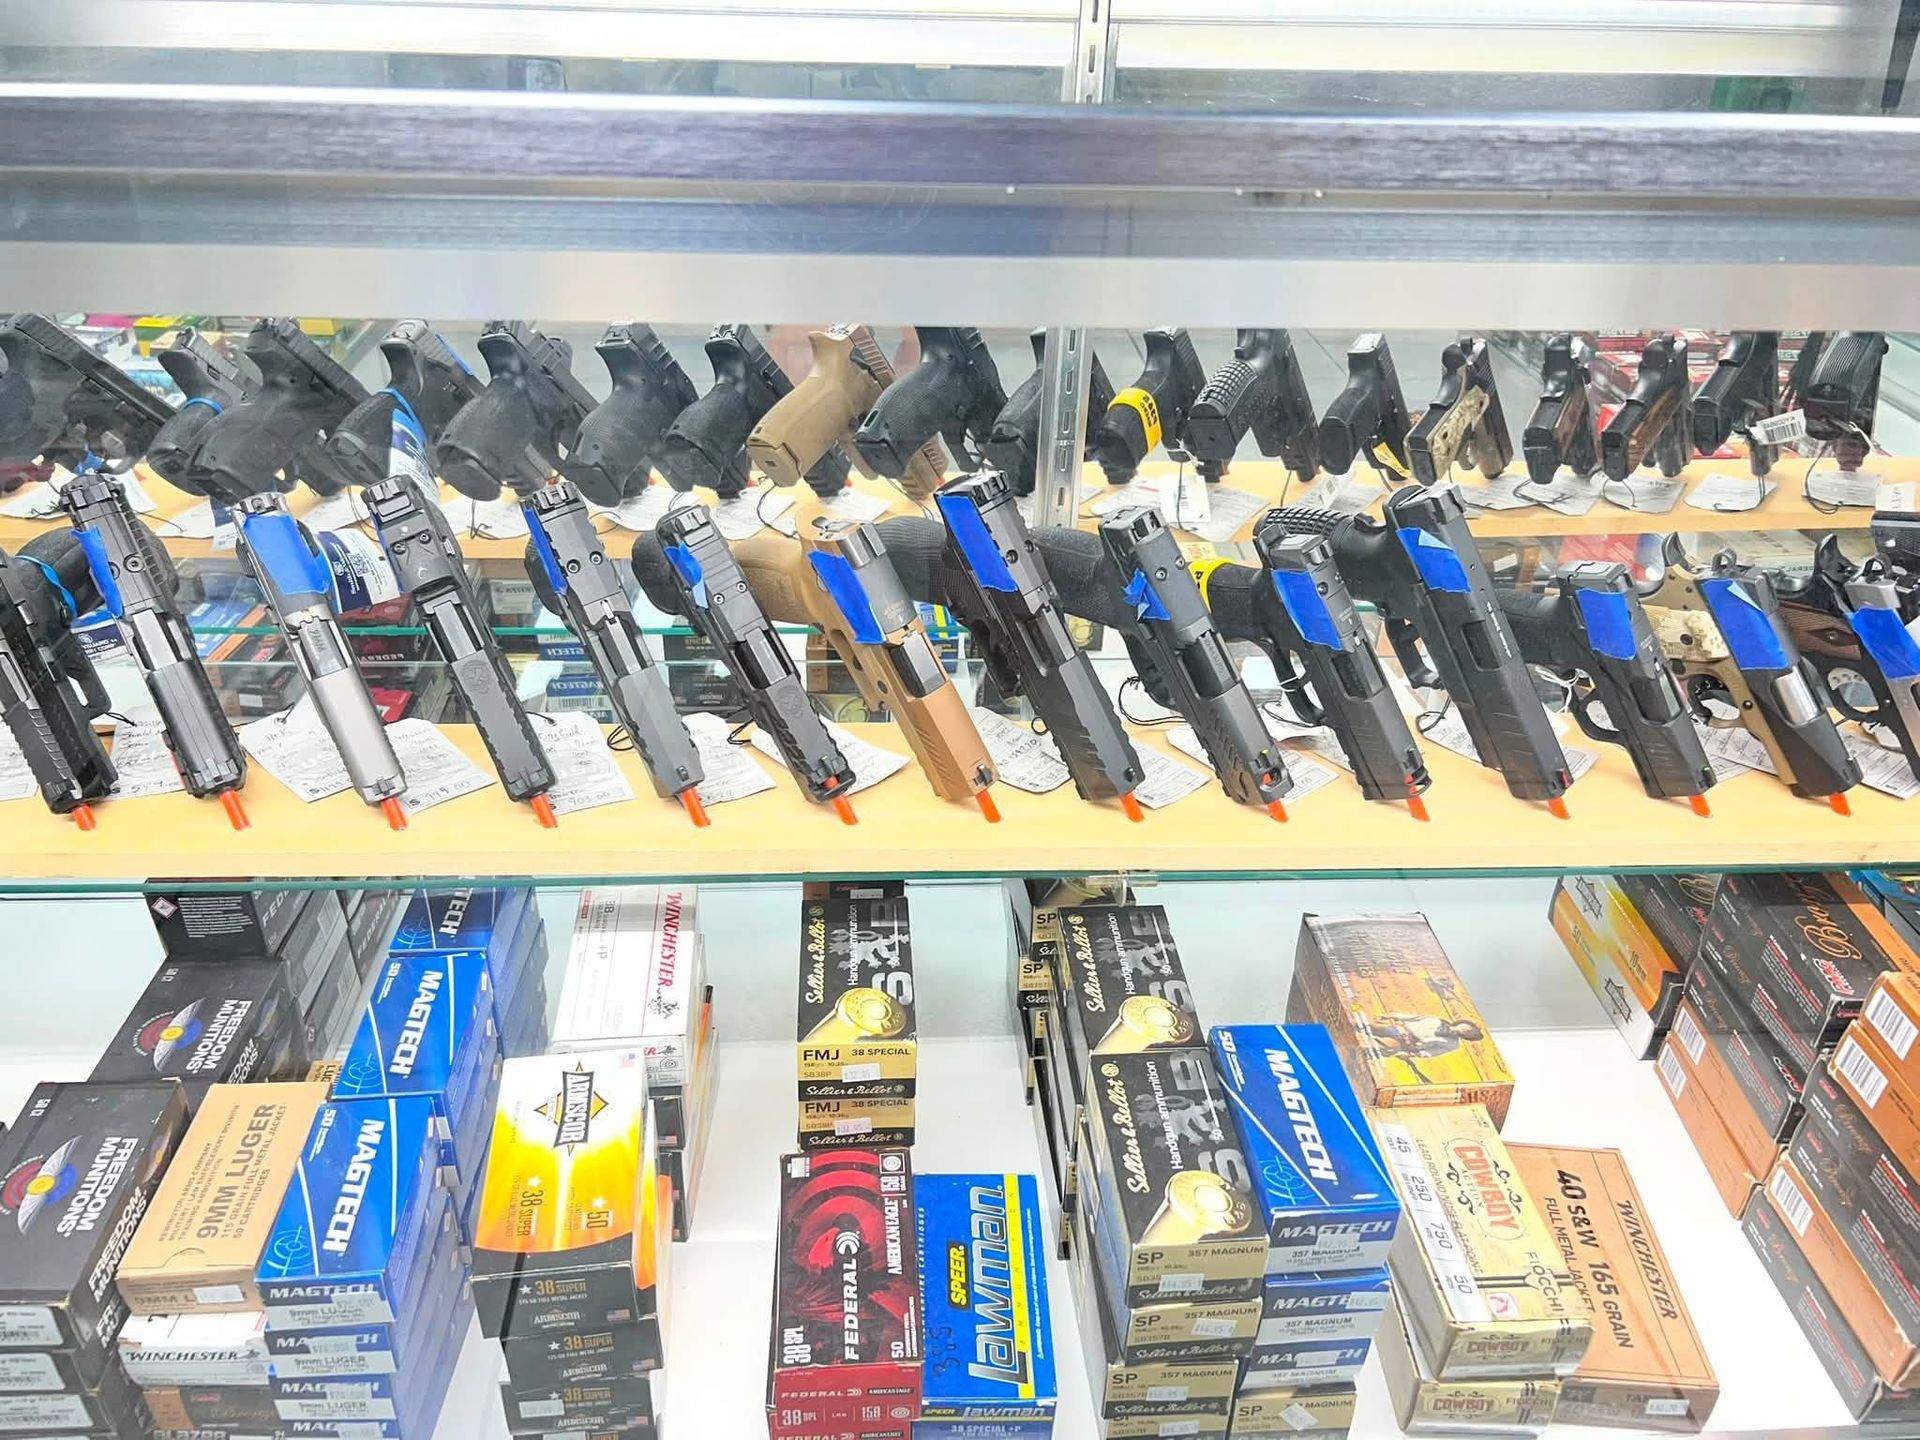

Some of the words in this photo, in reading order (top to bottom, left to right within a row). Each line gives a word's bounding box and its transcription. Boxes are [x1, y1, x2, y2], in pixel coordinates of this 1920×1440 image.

[438, 886, 475, 936] TECH
[1037, 913, 1057, 924] SP
[657, 892, 682, 988] WINCHESTER
[1072, 925, 1095, 962] Bellot
[1108, 912, 1126, 957] ammunition
[1023, 964, 1044, 974] SP
[1120, 959, 1136, 995] Handgun
[186, 999, 239, 1074] MUNITIONS
[202, 1000, 253, 1070] FREEDOM
[389, 970, 443, 1078] MAGTECH
[226, 1038, 255, 1084] EDOM
[803, 1049, 840, 1061] FMJ
[851, 1048, 865, 1056] 38
[867, 1048, 910, 1056] SPECIAL
[805, 1085, 845, 1096] Sellier
[854, 1085, 892, 1095] Bellot
[1107, 1077, 1134, 1127] Bellot
[1146, 1060, 1170, 1122] ammunition
[560, 1073, 593, 1145] ARMSCOR
[805, 1101, 840, 1113] FMJ
[867, 1099, 909, 1107] SPECIAL
[1264, 1048, 1338, 1185] MAGTECH
[809, 1136, 846, 1146] Sellier
[856, 1135, 892, 1144] Bellot
[1163, 1122, 1184, 1170] Handgun
[196, 1185, 240, 1239] 9MM
[225, 1103, 278, 1178] LUGER
[243, 1166, 260, 1190] FULL
[254, 1137, 273, 1168] METAL
[1122, 1137, 1150, 1193] Sellier
[57, 1136, 121, 1238] MUNITIONS
[76, 1137, 139, 1232] FREEDOM
[239, 1168, 271, 1226] CARTRIDGES
[322, 1119, 386, 1253] MAGTECH
[1411, 1175, 1433, 1202] 250
[1453, 1145, 1520, 1231] COWBOY
[1558, 1169, 1587, 1200] 40
[521, 1189, 544, 1208] 38
[883, 1198, 900, 1226] EAGLE
[515, 1209, 535, 1236] SUPER
[586, 1210, 610, 1230] 50
[1278, 1220, 1393, 1239] MAGTECH
[1567, 1204, 1600, 1249] S&W
[88, 1186, 142, 1291] FREEDOM
[94, 1190, 147, 1303] MUNITIONS
[1430, 1221, 1453, 1250] 750
[885, 1226, 903, 1275] AMERICAN
[1136, 1251, 1164, 1265] SP
[1187, 1249, 1210, 1258] 357
[1211, 1246, 1265, 1256] MAGNUM
[1291, 1250, 1308, 1258] 357
[1544, 1196, 1564, 1225] FULL
[1555, 1226, 1578, 1264] METAL
[1567, 1266, 1597, 1313] JACKET
[1616, 1199, 1679, 1321] WINCHESTER
[535, 1279, 555, 1296] 38
[556, 1282, 587, 1295] SUPER
[949, 1244, 968, 1307] SPEER
[968, 1184, 1028, 1385] Lawman
[1453, 1274, 1473, 1295] 50
[1525, 1251, 1565, 1313] FIOCCHI
[1588, 1261, 1620, 1297] 165
[269, 1282, 375, 1299] MAGTECH
[1272, 1294, 1352, 1311] MAGTE
[534, 1311, 581, 1325] ARMSCOR
[842, 1258, 860, 1361] FEDERAL
[1134, 1314, 1161, 1328] SP
[1184, 1312, 1206, 1320] 357
[1207, 1308, 1258, 1318] MAGNUM
[1284, 1320, 1302, 1328] 357
[1304, 1317, 1353, 1327] MAGNUM
[1603, 1300, 1635, 1349] GRAIN
[276, 1333, 379, 1348] MACH
[563, 1335, 584, 1350] 38
[584, 1335, 613, 1349] SUPER
[783, 1343, 812, 1365] 38
[891, 1341, 904, 1358] 50
[1466, 1340, 1530, 1353] COWBOY
[125, 1350, 239, 1362] WINCHESTER
[324, 1355, 366, 1365] LUGER
[1257, 1348, 1364, 1365] MACH
[562, 1364, 608, 1378] ARMSCOR
[1112, 1373, 1138, 1385] SP
[1160, 1371, 1181, 1380] 357
[1183, 1368, 1233, 1379] MAGNUM
[327, 1401, 367, 1410] LUGER
[563, 1387, 583, 1402] 38
[781, 1390, 846, 1399] FEDERAL
[1432, 1397, 1495, 1412] COWBOY
[557, 1416, 605, 1428] ARMSCOR
[782, 1409, 802, 1426] 38
[924, 1408, 956, 1416] SPEER
[1237, 1405, 1263, 1417] SP
[967, 1425, 1006, 1433] SPECIAL
